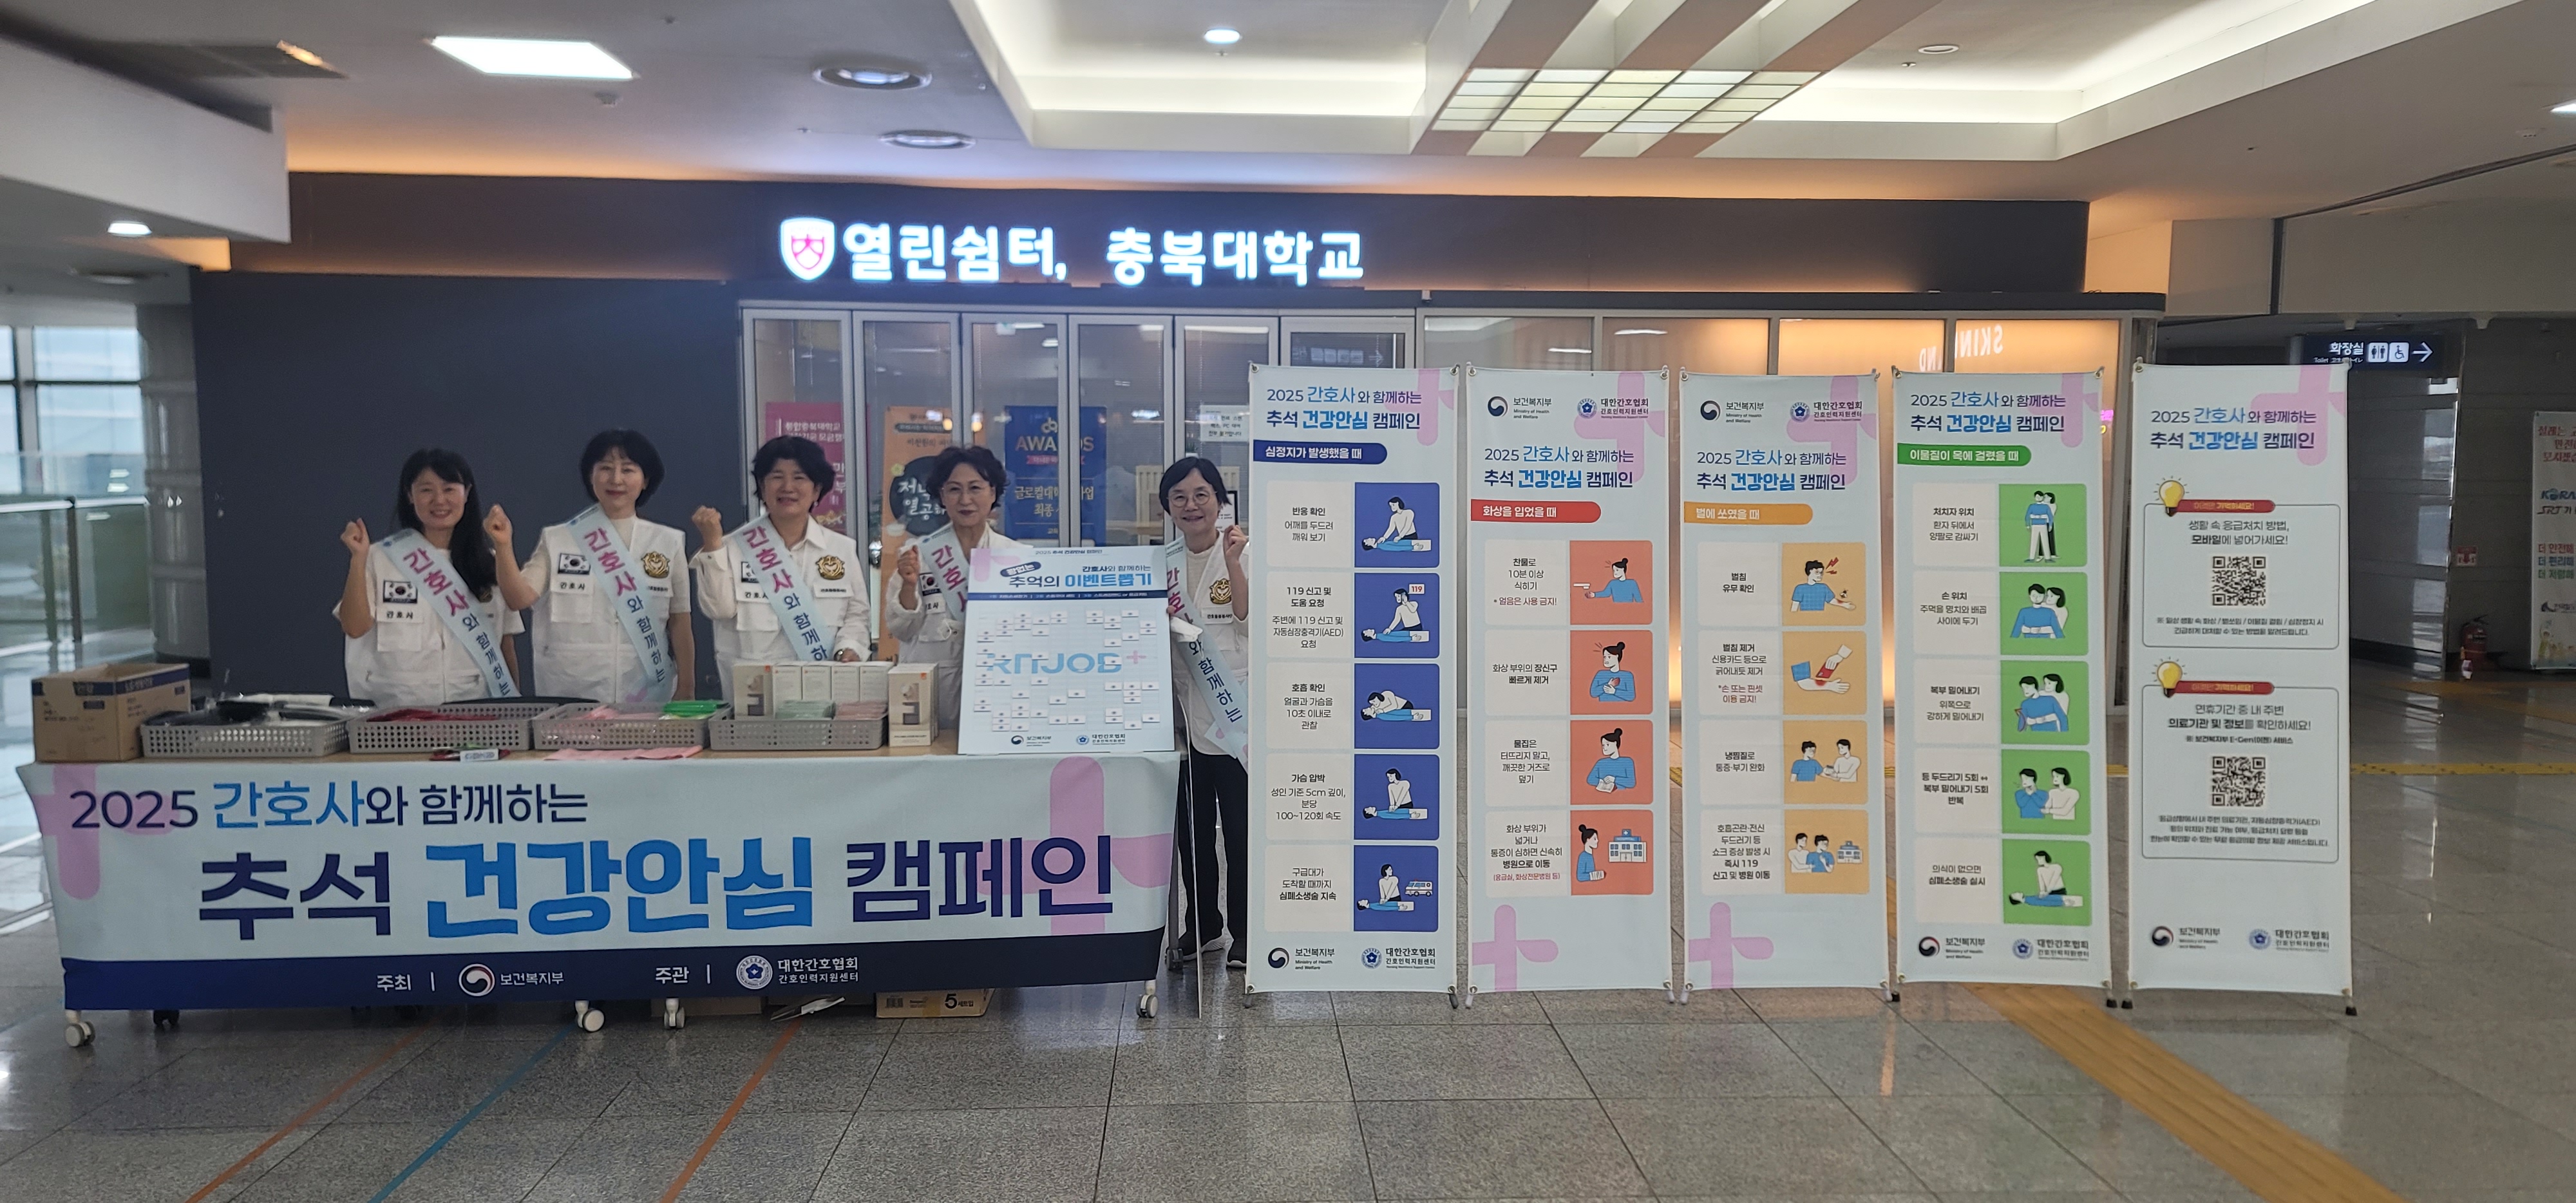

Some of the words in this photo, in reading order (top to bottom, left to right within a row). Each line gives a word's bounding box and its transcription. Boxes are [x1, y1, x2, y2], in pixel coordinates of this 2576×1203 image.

[843, 222, 1066, 282] 열린쉼터,
[1106, 227, 1363, 288] 충북대학교
[2329, 343, 2363, 355] 화장실
[1267, 390, 1303, 401] 2025
[1374, 391, 1421, 404] 함께하는
[1513, 398, 1551, 406] 보건복지부
[1601, 399, 1649, 407] 대한간호협회
[1911, 395, 1947, 406] 2025
[2017, 395, 2066, 408] 함께하는
[1726, 402, 1764, 411] 보건복지부
[1814, 402, 1862, 410] 대한간호협회
[1267, 410, 1298, 428] 추석
[1303, 411, 1368, 430] 건강안심
[1373, 413, 1420, 429] 캠페인
[2151, 411, 2190, 422] 2025
[2264, 410, 2316, 424] 함께하는
[1911, 415, 1942, 431] 추석
[1947, 415, 2011, 432] 건강안심
[2017, 415, 2064, 432] 캠페인
[1016, 436, 1094, 451] AWAS
[2150, 432, 2183, 448] 추석
[2189, 432, 2258, 450] 건강안심
[2264, 432, 2315, 449] 캠페인
[1265, 446, 1306, 458] 심정지가
[1309, 447, 1349, 459] 발생했을
[1352, 448, 1361, 459] 때
[1484, 449, 1519, 460] 2025
[1586, 450, 1634, 462] 함께하는
[1697, 452, 1732, 464] 2025
[1800, 453, 1846, 465] 함께하는
[1910, 450, 1950, 460] 이물질이
[1953, 451, 1973, 461] 목에
[1975, 451, 2005, 461] 걸렸을
[2009, 451, 2019, 461] 때
[1484, 469, 1513, 487] 추석
[1519, 469, 1582, 488] 건강안심
[1587, 471, 1633, 488] 캠페인
[1697, 473, 1726, 490] 추석
[1731, 473, 1795, 491] 건강안심
[1800, 474, 1845, 491] 캠페인
[1483, 506, 1512, 516] 화상을
[1515, 506, 1544, 517] 입었을
[1547, 507, 1556, 517] 때
[1696, 508, 1715, 518] 벌에
[1718, 509, 1747, 519] 쏘였을
[1750, 509, 1759, 519] 때
[1933, 521, 1949, 529] 환자
[2189, 521, 2208, 530] 생활
[2211, 521, 2221, 530] 속
[2223, 521, 2263, 531] 응급처치
[2266, 522, 2289, 531] 방법,
[1929, 533, 1953, 541] 양팔로
[2191, 535, 2231, 544] 모바일에
[2234, 535, 2287, 545] 넣어가세요!
[1009, 576, 1059, 587] 추억의
[1065, 573, 1151, 587] 이벤트뽑기
[1508, 570, 1526, 578] 10분
[1529, 570, 1544, 578] 이상
[1732, 573, 1747, 581] 벌침
[743, 525, 801, 611] 간호사와
[793, 612, 829, 661] 함께하
[1723, 584, 1738, 592] 유무
[1739, 584, 1754, 592] 확인
[1951, 592, 1967, 600] 위치
[584, 527, 644, 614] 간호사와
[637, 615, 666, 683] 함께하는
[1309, 599, 1324, 607] 요청
[402, 546, 480, 630] 간호사와
[475, 631, 511, 696] 함께하는
[1744, 655, 1766, 663] 등으로
[1493, 664, 1508, 672] 화상
[1510, 664, 1533, 672] 부위의
[1535, 664, 1557, 672] 장신구
[1198, 657, 1244, 723] 함께하는
[1725, 752, 1755, 760] 냉찜질로
[1292, 774, 1307, 782] 가슴
[1309, 774, 1325, 782] 압박
[70, 790, 198, 829] 2025
[213, 780, 408, 828] 간호사와
[420, 784, 587, 825] 함께하는
[1293, 868, 1324, 876] 구급대가
[200, 851, 392, 940] 추석
[426, 837, 813, 938] 건강안심
[847, 835, 1112, 922] 캠페인
[1295, 948, 1334, 957] 보건복지부
[1386, 948, 1435, 957] 대한간호협회
[778, 957, 858, 972] 대한간호협회
[500, 971, 564, 987] 보건복지부
[655, 966, 689, 985] 주관
[779, 972, 858, 983] 간호인력지원센터
[377, 974, 412, 991] 주최
